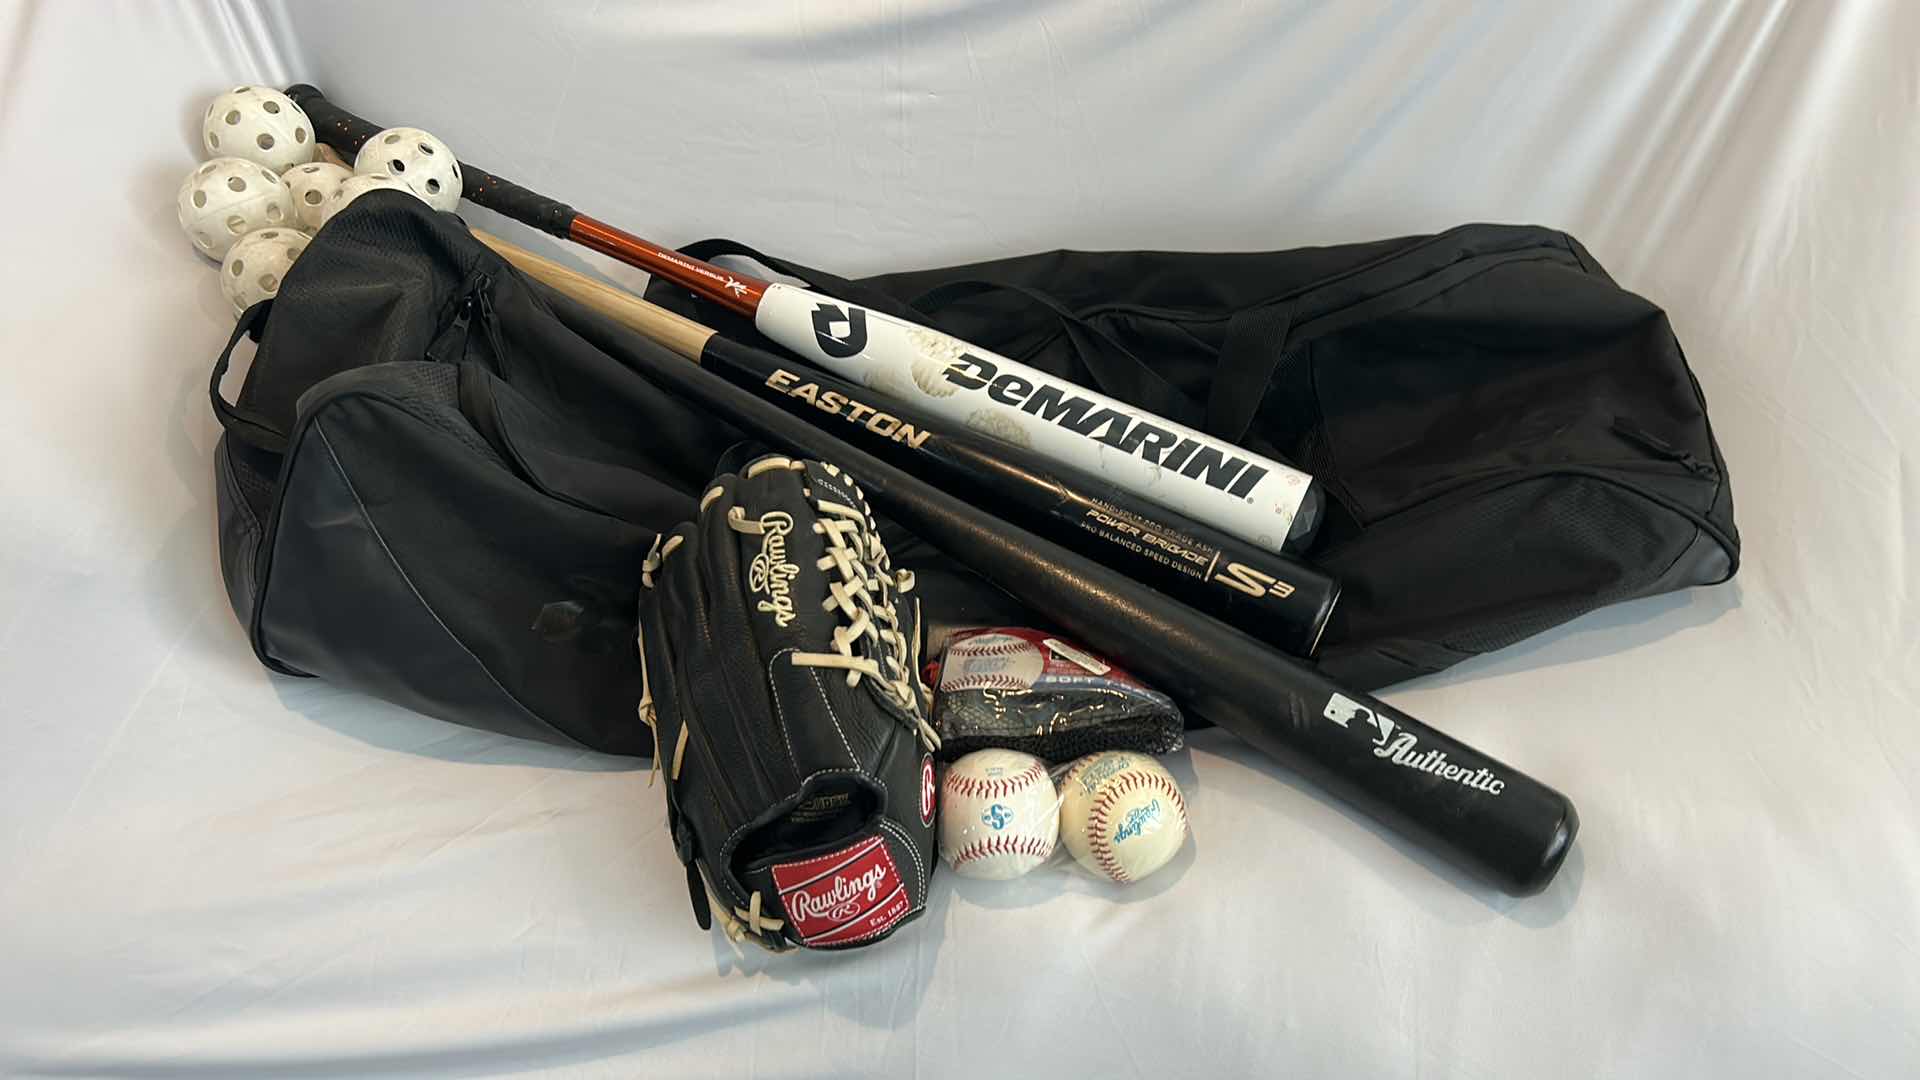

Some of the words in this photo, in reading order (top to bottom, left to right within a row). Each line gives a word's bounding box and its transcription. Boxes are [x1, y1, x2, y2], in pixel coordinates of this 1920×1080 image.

[765, 368, 931, 449] EASTON
[1081, 520, 1098, 533] PRO
[1099, 529, 1143, 553] BALANCED
[1144, 548, 1170, 565] SPEED
[1171, 560, 1202, 579] DESIGN
[1086, 508, 1141, 537] POWER
[1142, 532, 1209, 566] BRIGADE
[757, 511, 800, 627] Rawlings
[1373, 732, 1505, 795] Authentic
[1113, 798, 1160, 844] Rawlings
[791, 864, 886, 922] Rawlings
